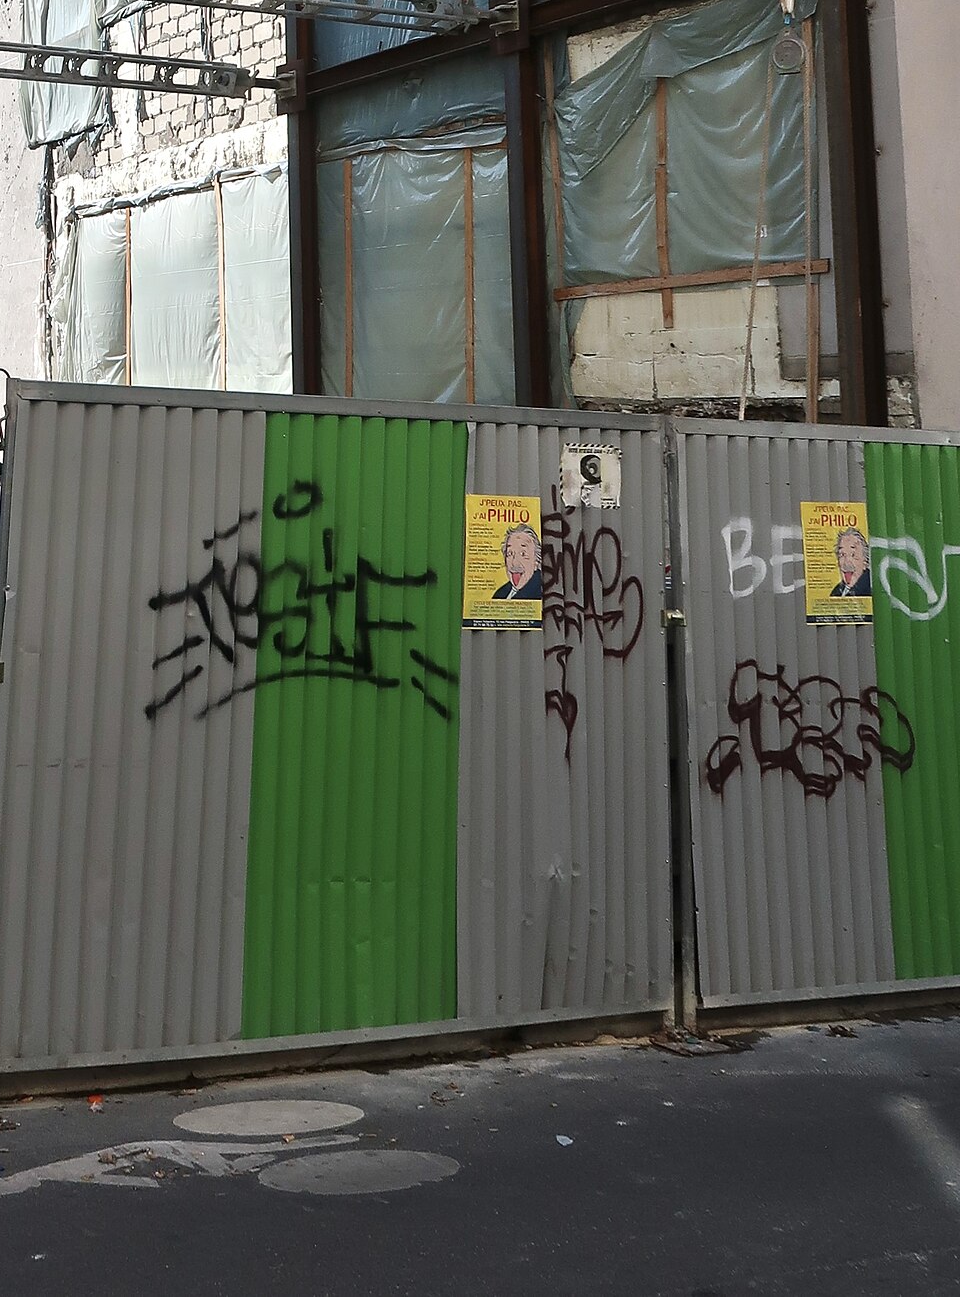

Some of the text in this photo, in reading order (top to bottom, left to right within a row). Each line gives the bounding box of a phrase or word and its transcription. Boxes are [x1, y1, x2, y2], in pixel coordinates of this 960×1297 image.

[479, 499, 505, 507] J'PEUX
[487, 508, 530, 523] PHILO
[821, 514, 857, 527] PHILO
